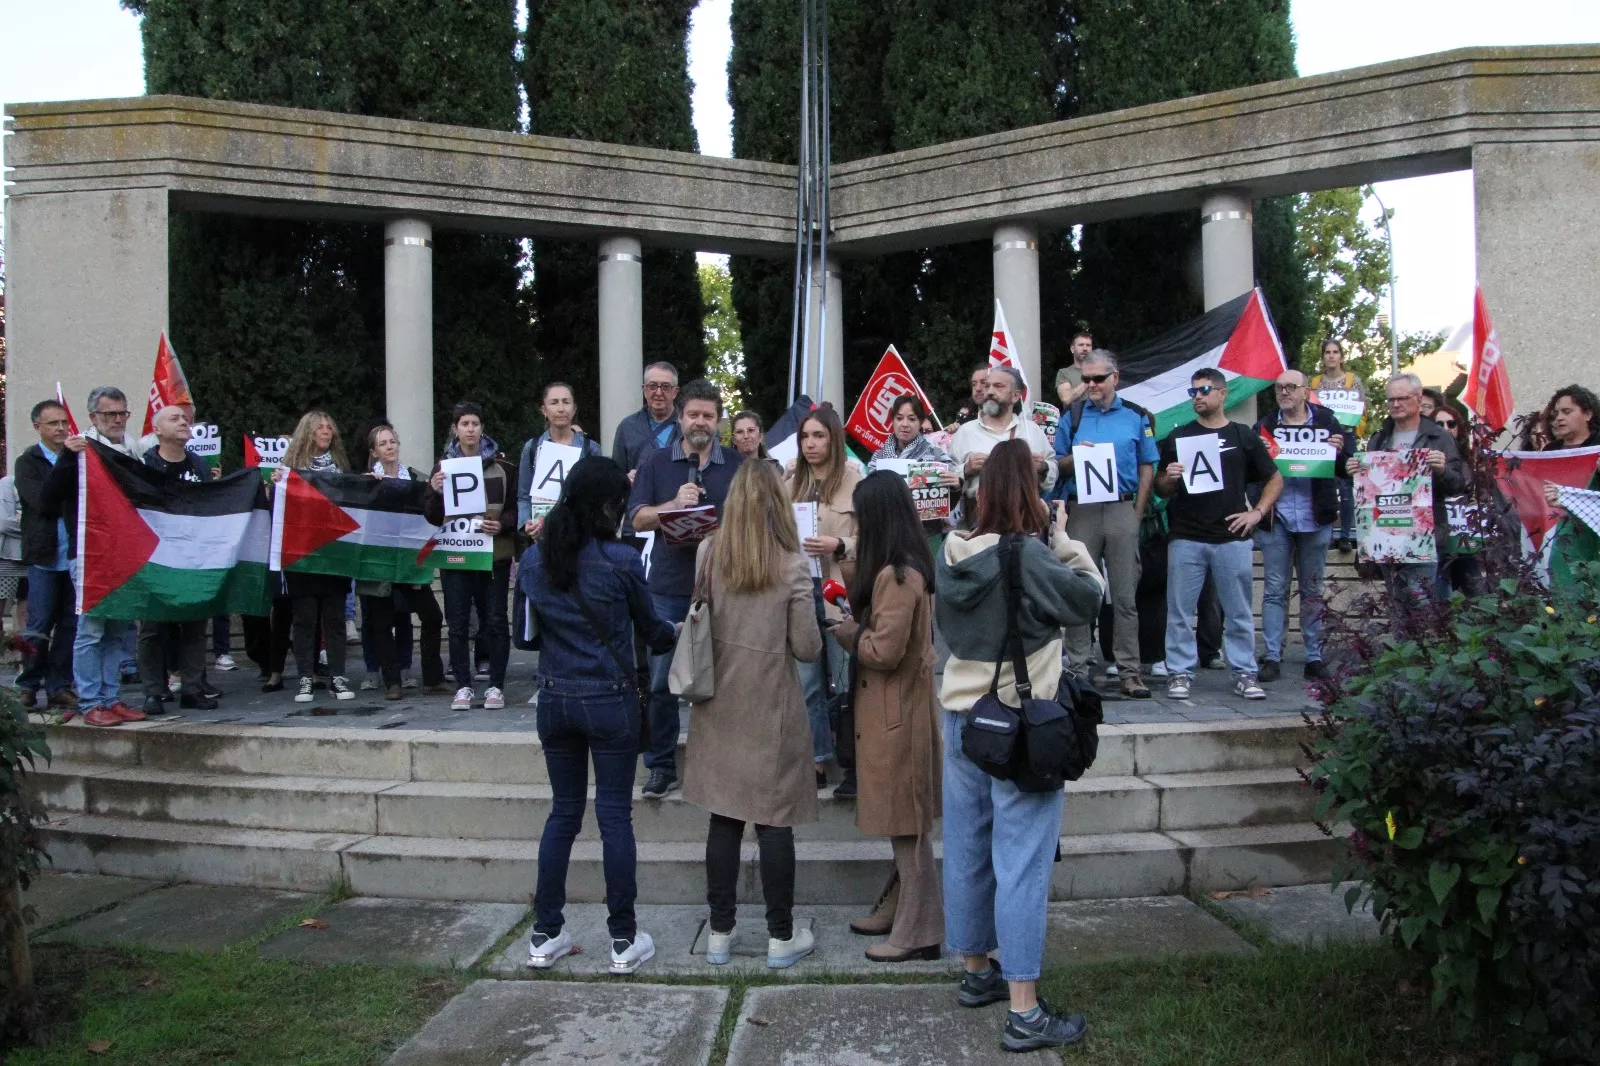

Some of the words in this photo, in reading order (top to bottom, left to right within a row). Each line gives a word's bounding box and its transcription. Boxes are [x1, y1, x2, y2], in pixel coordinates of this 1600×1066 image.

[869, 376, 908, 426] UGT
[1318, 390, 1360, 401] STOP
[190, 424, 219, 439] OP
[1273, 427, 1330, 443] STOP
[254, 437, 290, 451] STO
[1272, 447, 1327, 456] GENOCIDIO
[537, 459, 566, 490] A
[1189, 450, 1220, 487] A
[1083, 458, 1114, 496] N
[451, 472, 479, 507] P
[911, 487, 949, 500] STOP
[915, 498, 948, 510] ENOCIDIO
[1378, 495, 1409, 506] STOP
[442, 517, 483, 534] TOP
[659, 510, 718, 538] UGT
